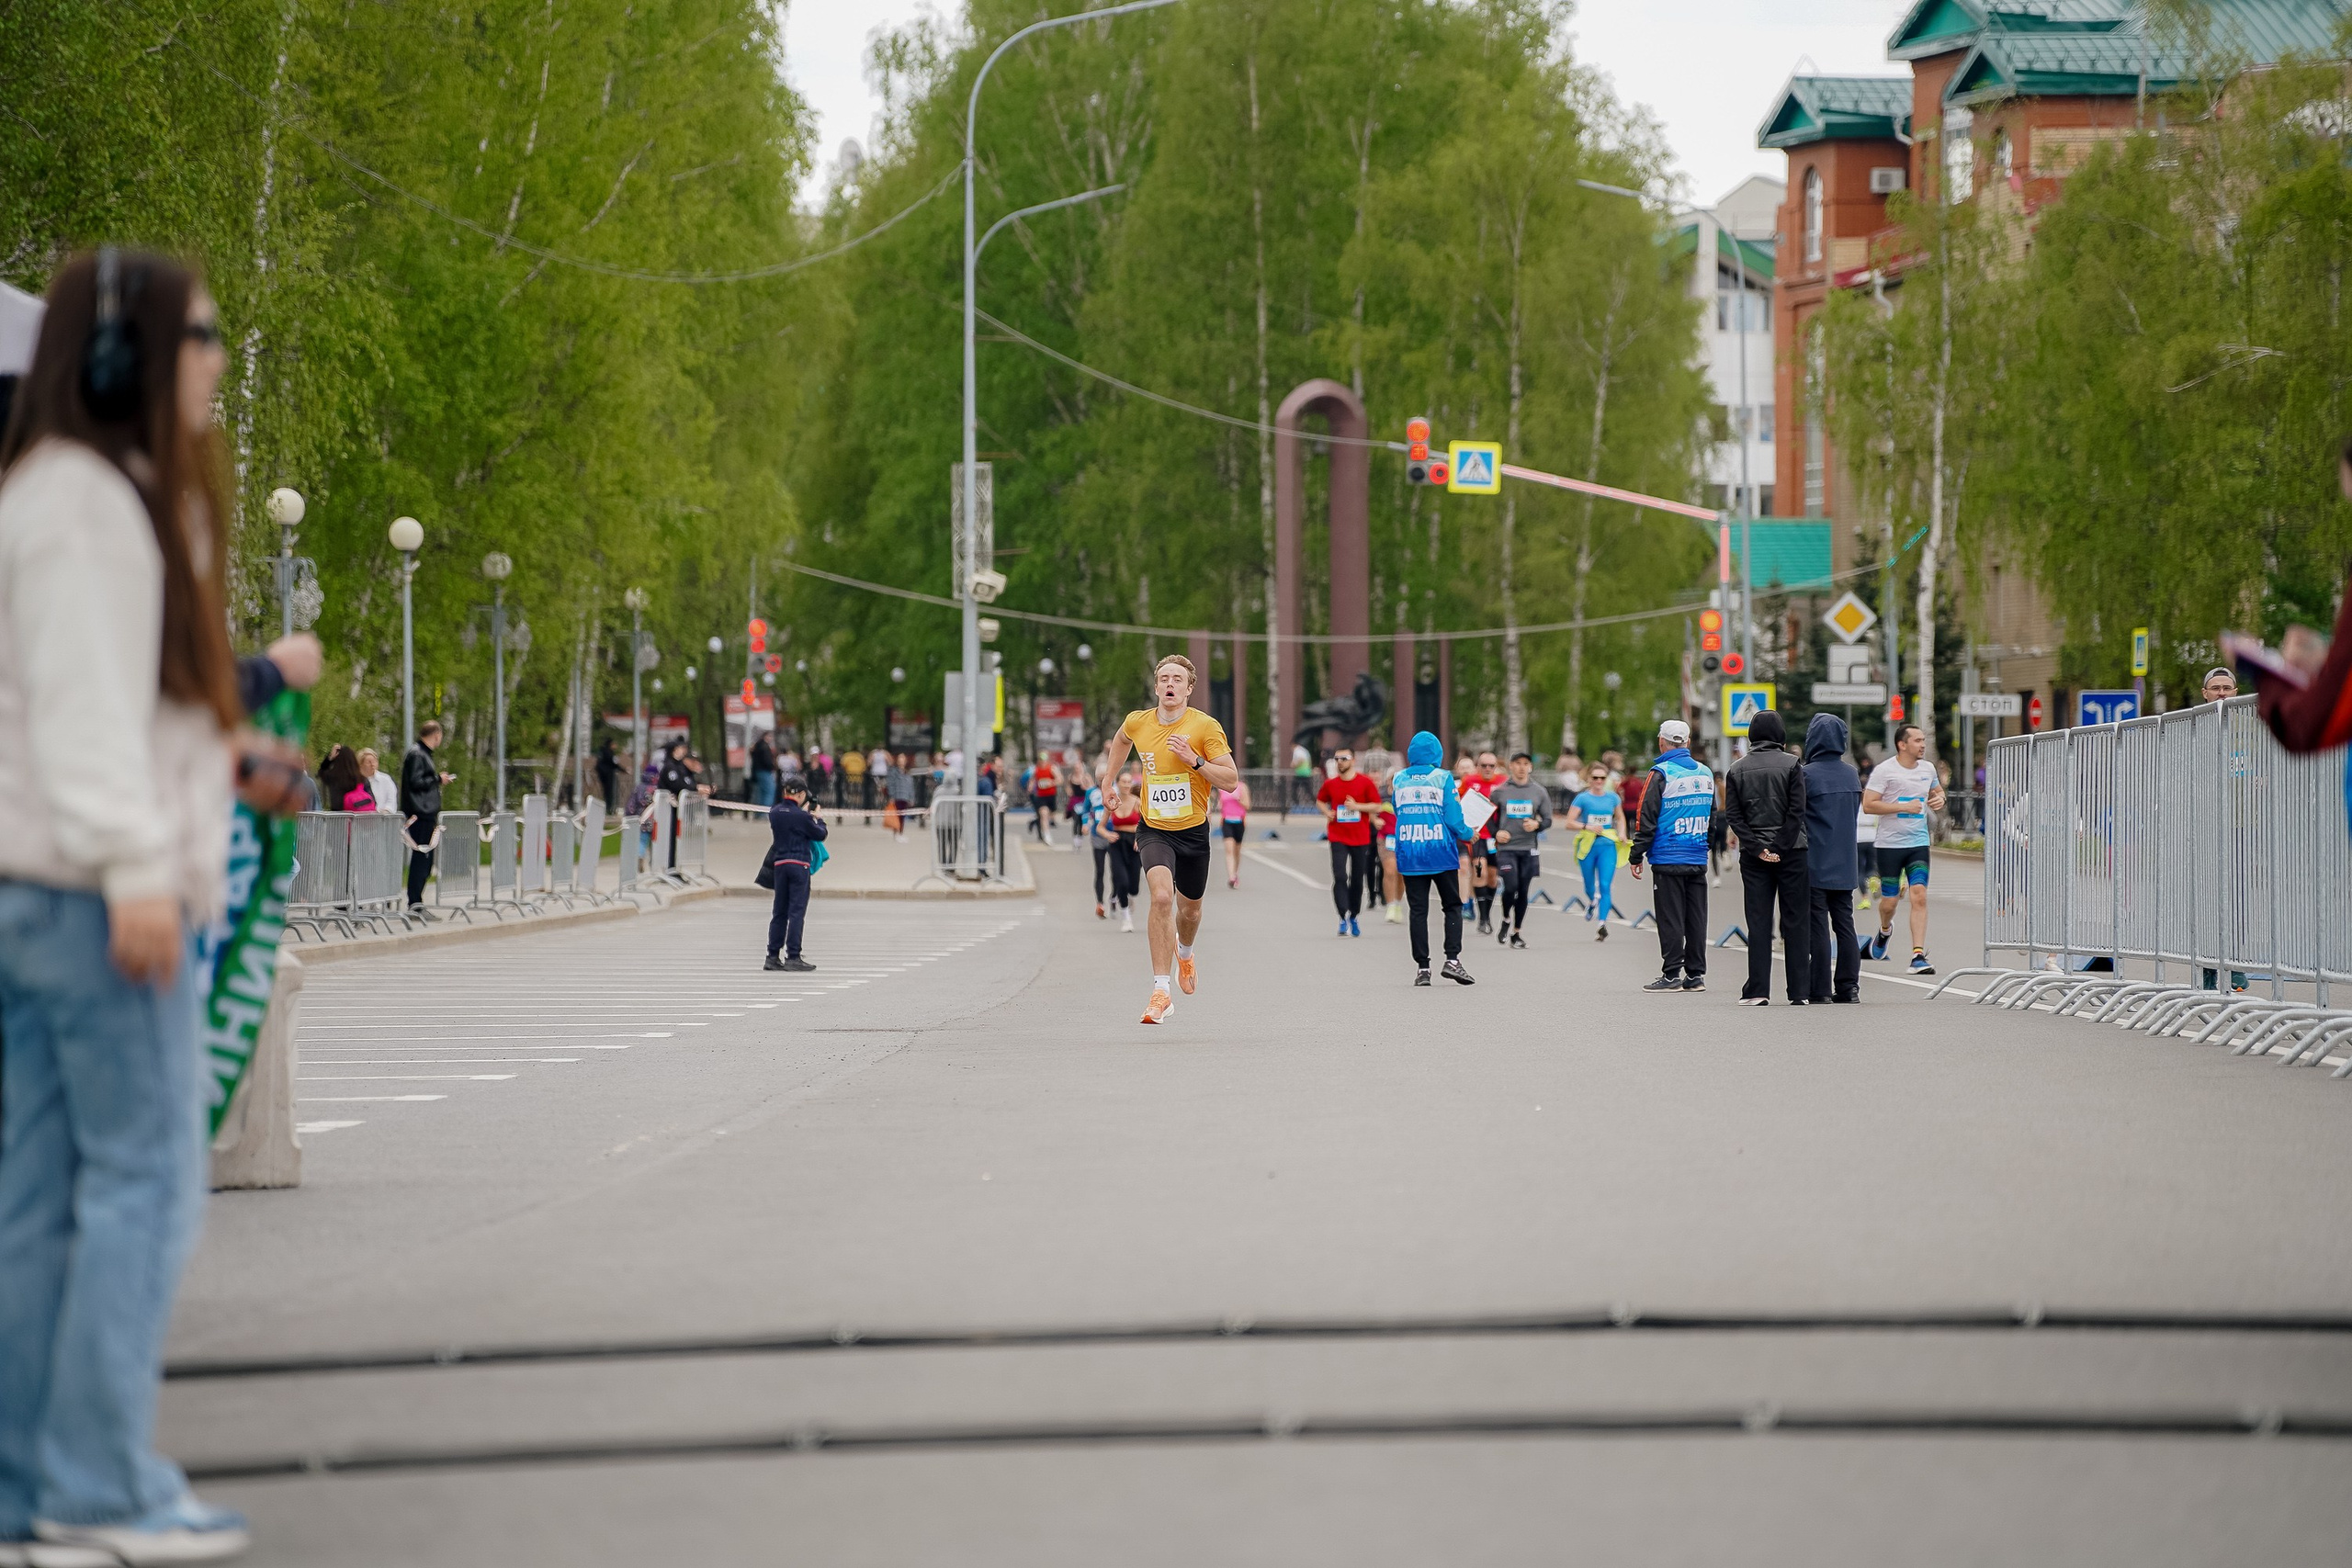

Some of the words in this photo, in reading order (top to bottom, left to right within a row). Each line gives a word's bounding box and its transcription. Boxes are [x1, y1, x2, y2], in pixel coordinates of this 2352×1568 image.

[1970, 697, 2012, 712] СТОП
[1152, 788, 1186, 803] 4003
[1399, 824, 1443, 842] СУДЬЯ
[1675, 817, 1710, 836] СУДЬ
